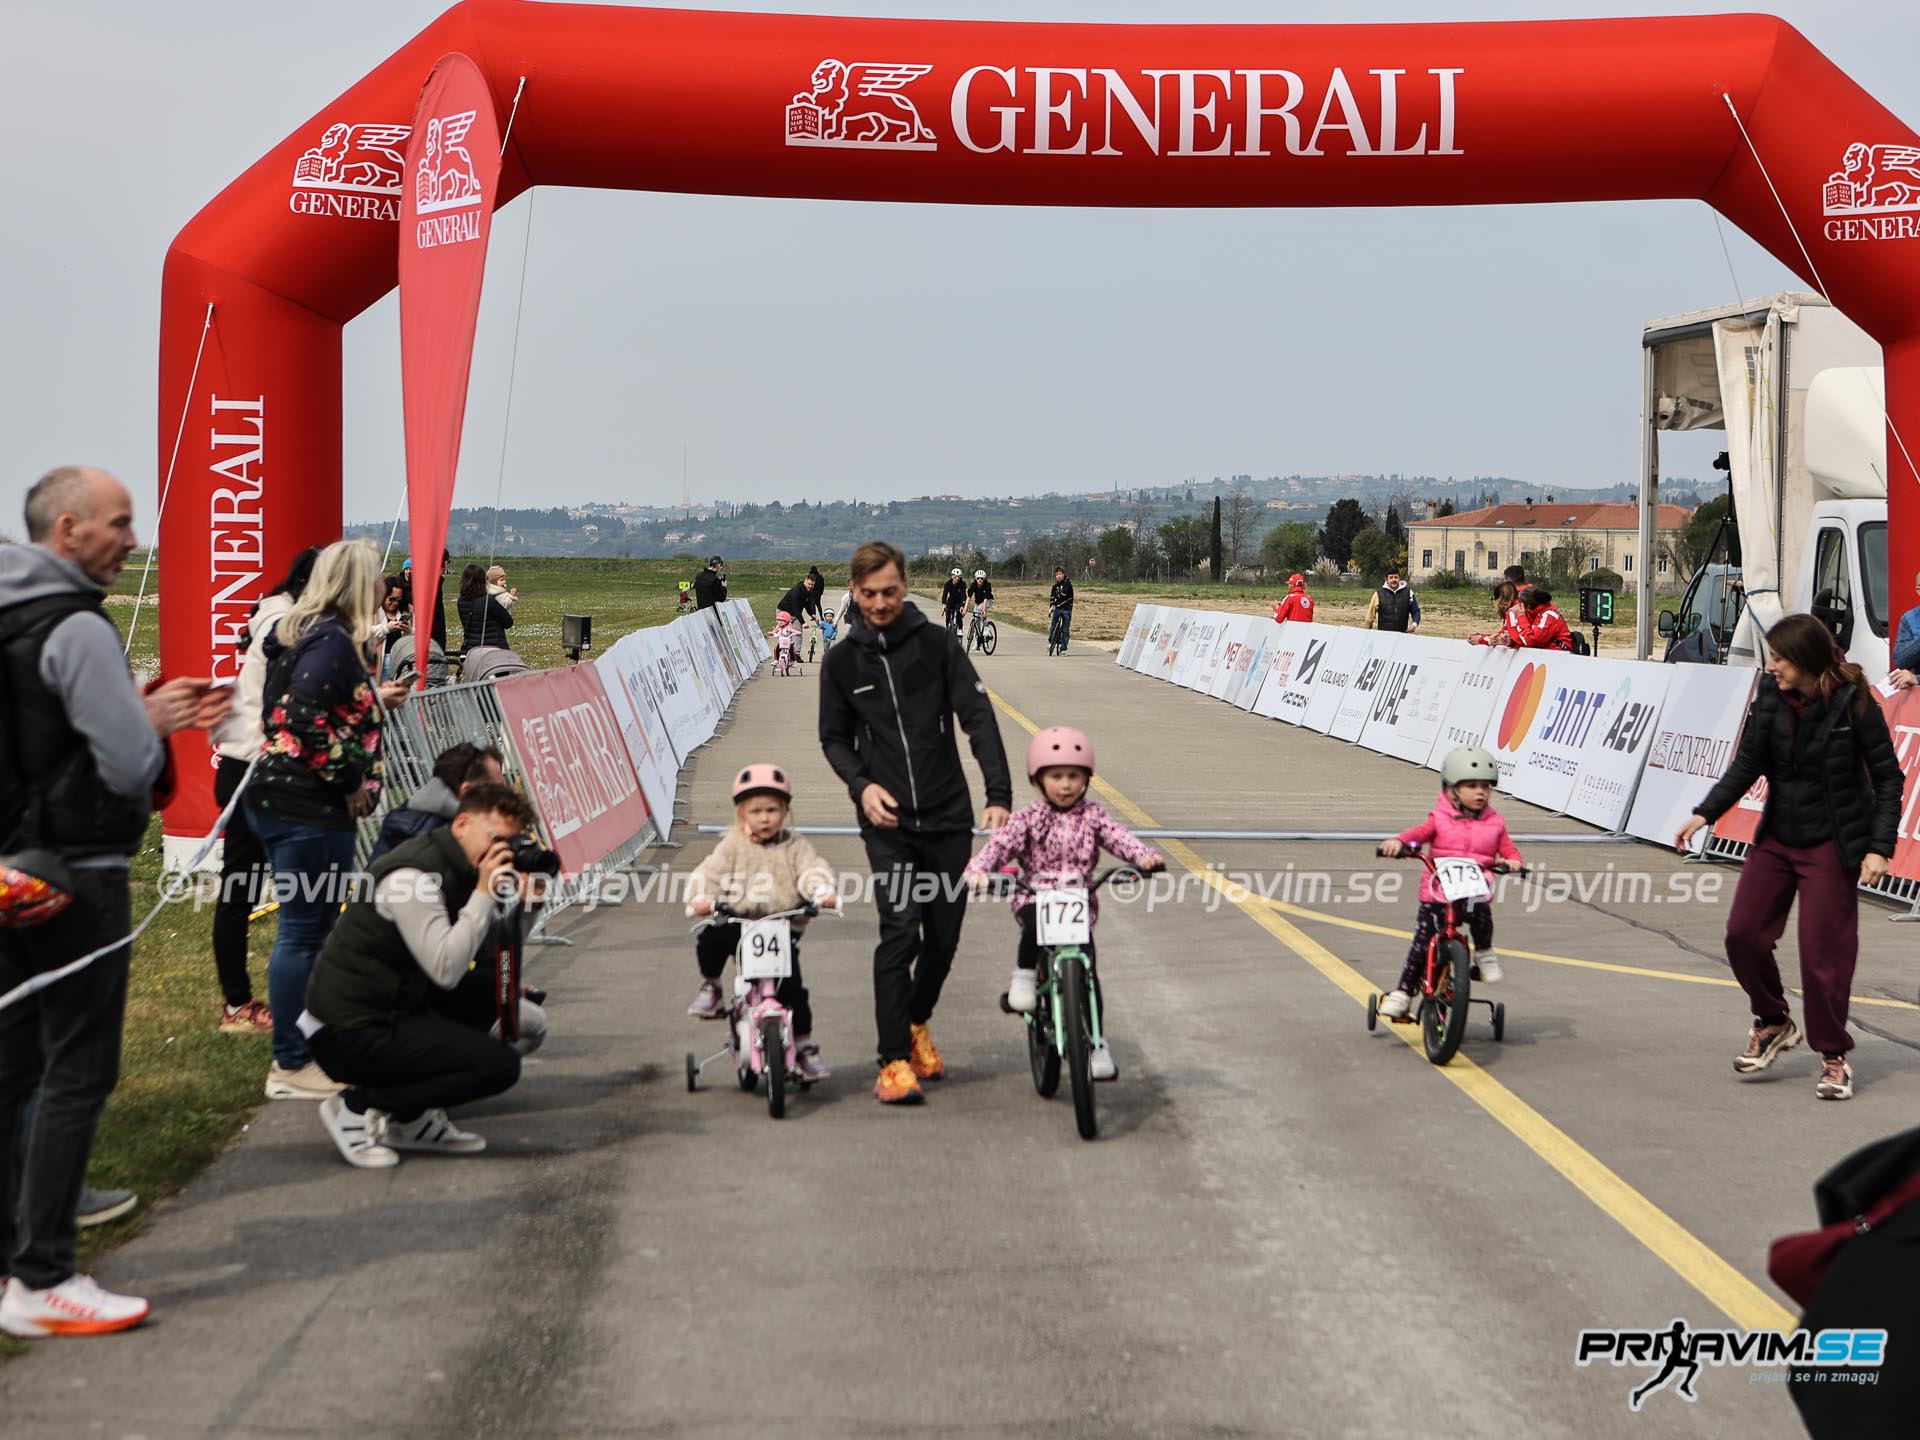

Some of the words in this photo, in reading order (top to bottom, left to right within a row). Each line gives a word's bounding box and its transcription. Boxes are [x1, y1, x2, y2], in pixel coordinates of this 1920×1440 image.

[950, 65, 1465, 157] GENERALI
[289, 191, 401, 221] GENERA
[416, 210, 482, 249] GENERALI
[1823, 216, 1920, 241] GENER
[1596, 592, 1612, 620] 13
[1320, 669, 1349, 688] COLNAGO
[1353, 658, 1387, 692] A2U
[1462, 672, 1495, 690] VOLVO
[1373, 661, 1419, 726] UAE
[1447, 727, 1480, 747] VOLVO
[1602, 701, 1655, 754] A2U
[1666, 733, 1731, 780] GENERALI
[1441, 865, 1480, 884] 173
[1041, 900, 1085, 924] 172
[752, 933, 780, 957] 94
